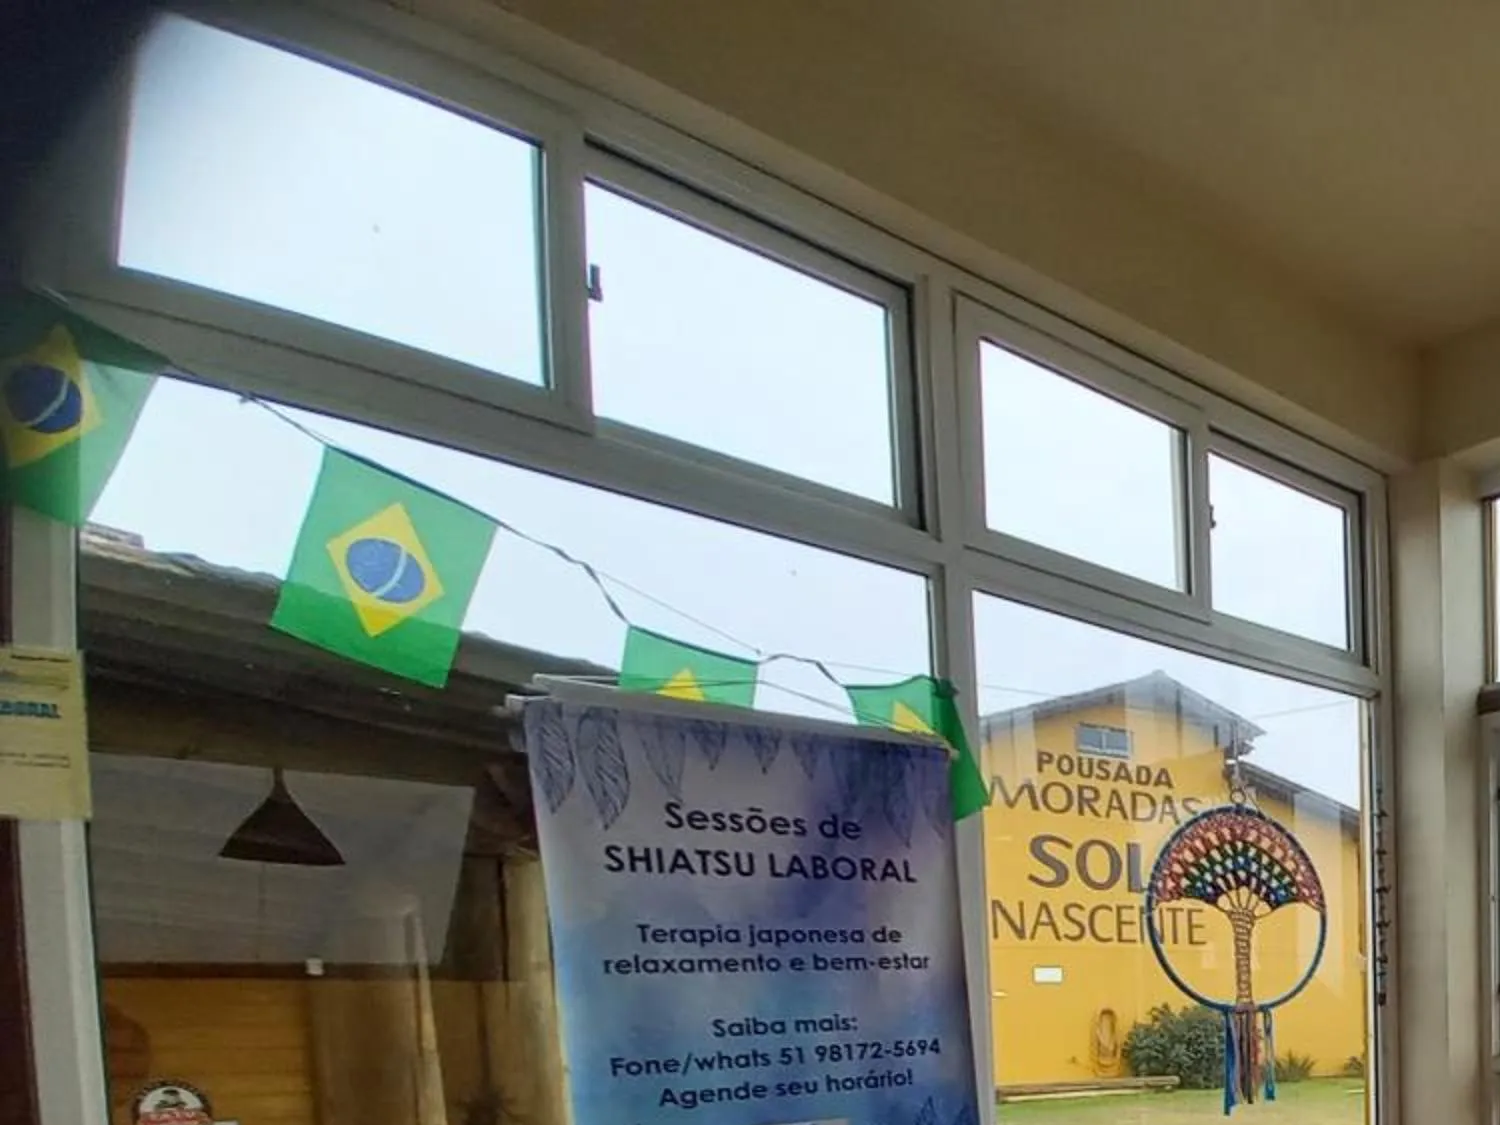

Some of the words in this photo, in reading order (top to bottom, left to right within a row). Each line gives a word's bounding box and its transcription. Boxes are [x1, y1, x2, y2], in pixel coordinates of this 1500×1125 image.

[1036, 750, 1175, 790] POUSADA
[987, 775, 1203, 825] MORADAS
[664, 801, 808, 837] Sessões
[818, 814, 863, 840] de
[604, 844, 756, 878] SHIATSU
[768, 853, 918, 884] LABORAL
[1026, 833, 1152, 894] SOL
[636, 923, 743, 950] Terapia
[747, 925, 866, 949] japonesa
[871, 926, 903, 945] de
[990, 898, 1208, 946] NASCENTE
[602, 953, 782, 976] relaxamento
[788, 955, 806, 972] e
[811, 953, 932, 973] bem-estar
[712, 1017, 787, 1039] Saiba
[794, 1013, 860, 1035] mais:
[609, 1049, 773, 1077] Fone/whats
[779, 1045, 804, 1067] 51
[816, 1037, 942, 1063] 98172-5694
[658, 1077, 769, 1110] Agende
[774, 1079, 820, 1097] seu
[824, 1068, 914, 1094] horário!
